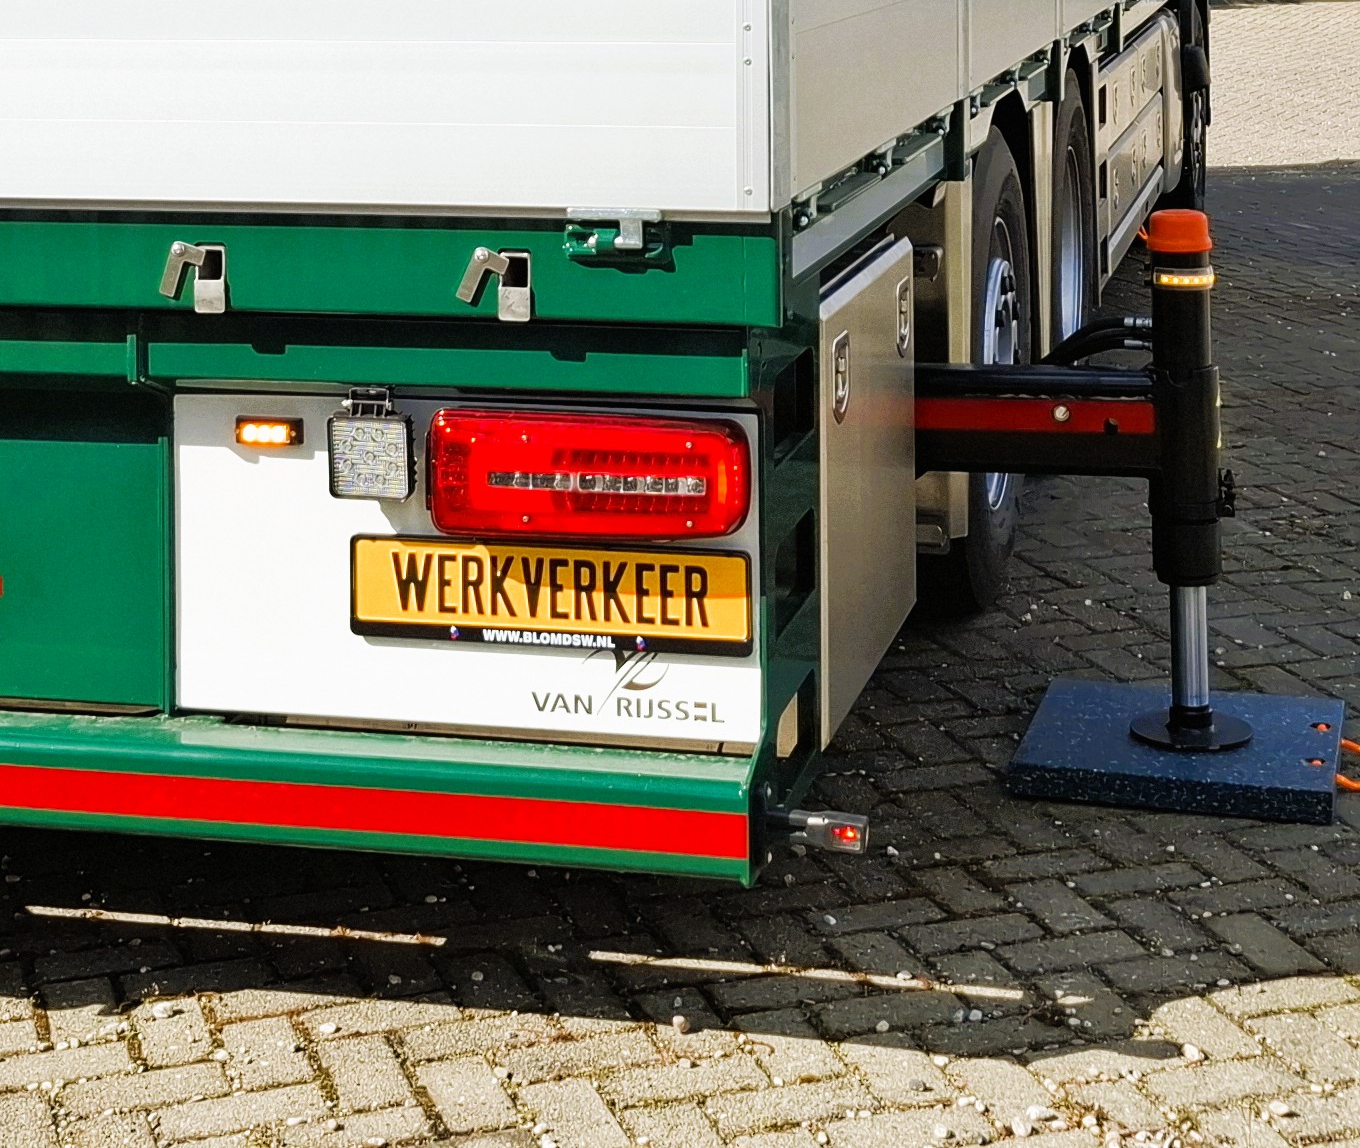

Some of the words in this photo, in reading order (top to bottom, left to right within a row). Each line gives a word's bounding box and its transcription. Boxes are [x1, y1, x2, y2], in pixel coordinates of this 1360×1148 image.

[391, 551, 710, 628] WERKVERKEER
[483, 628, 616, 649] WWW.BLOMDSW.NL
[530, 691, 594, 715] VAN
[616, 697, 726, 724] RIJSSEL
